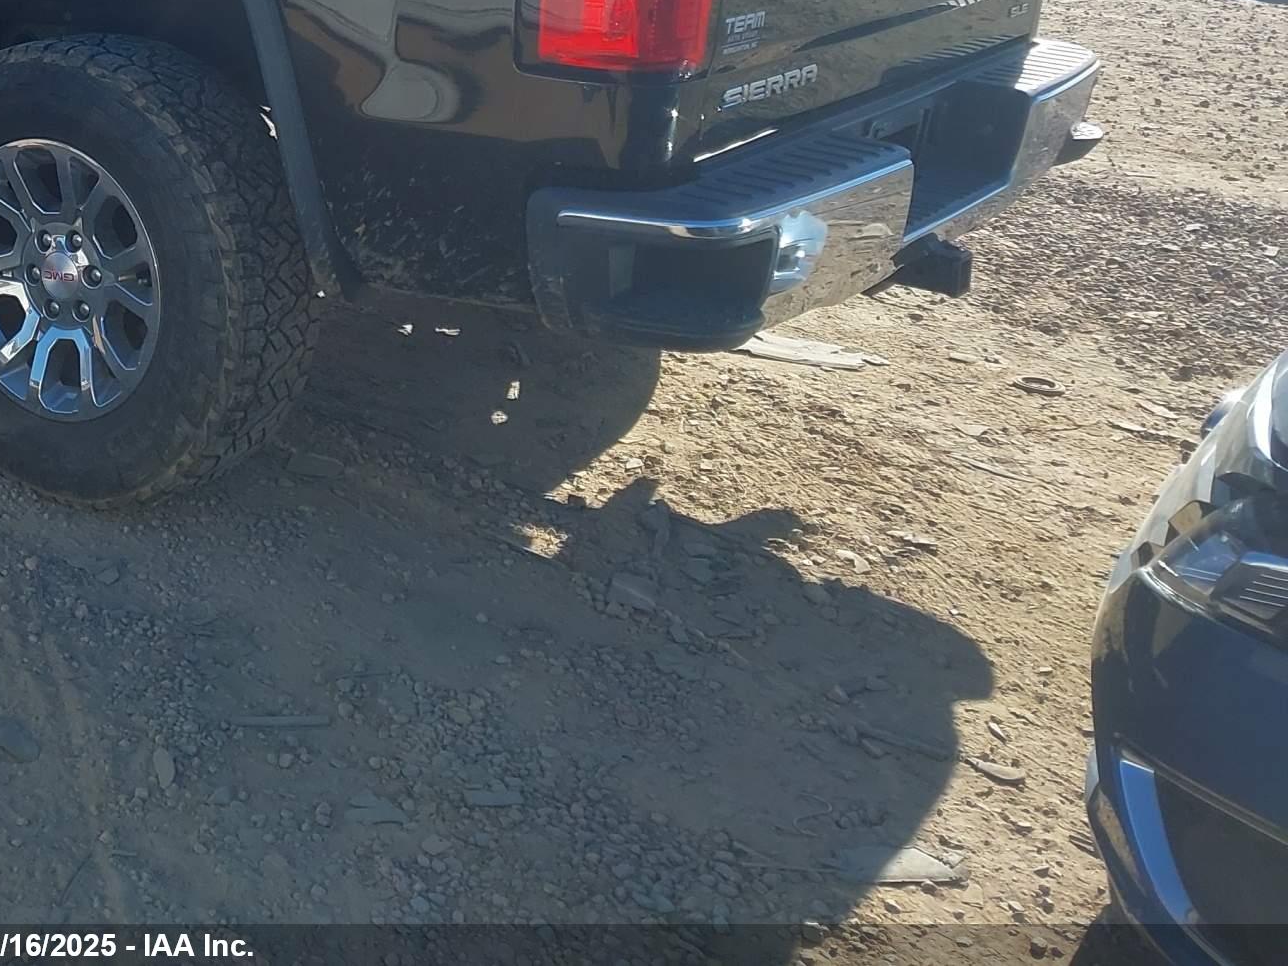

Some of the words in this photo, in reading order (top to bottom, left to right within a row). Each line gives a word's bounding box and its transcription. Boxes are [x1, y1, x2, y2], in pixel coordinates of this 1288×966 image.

[725, 10, 766, 35] TEAM
[721, 63, 818, 109] SIERRA
[43, 269, 75, 282] GMC
